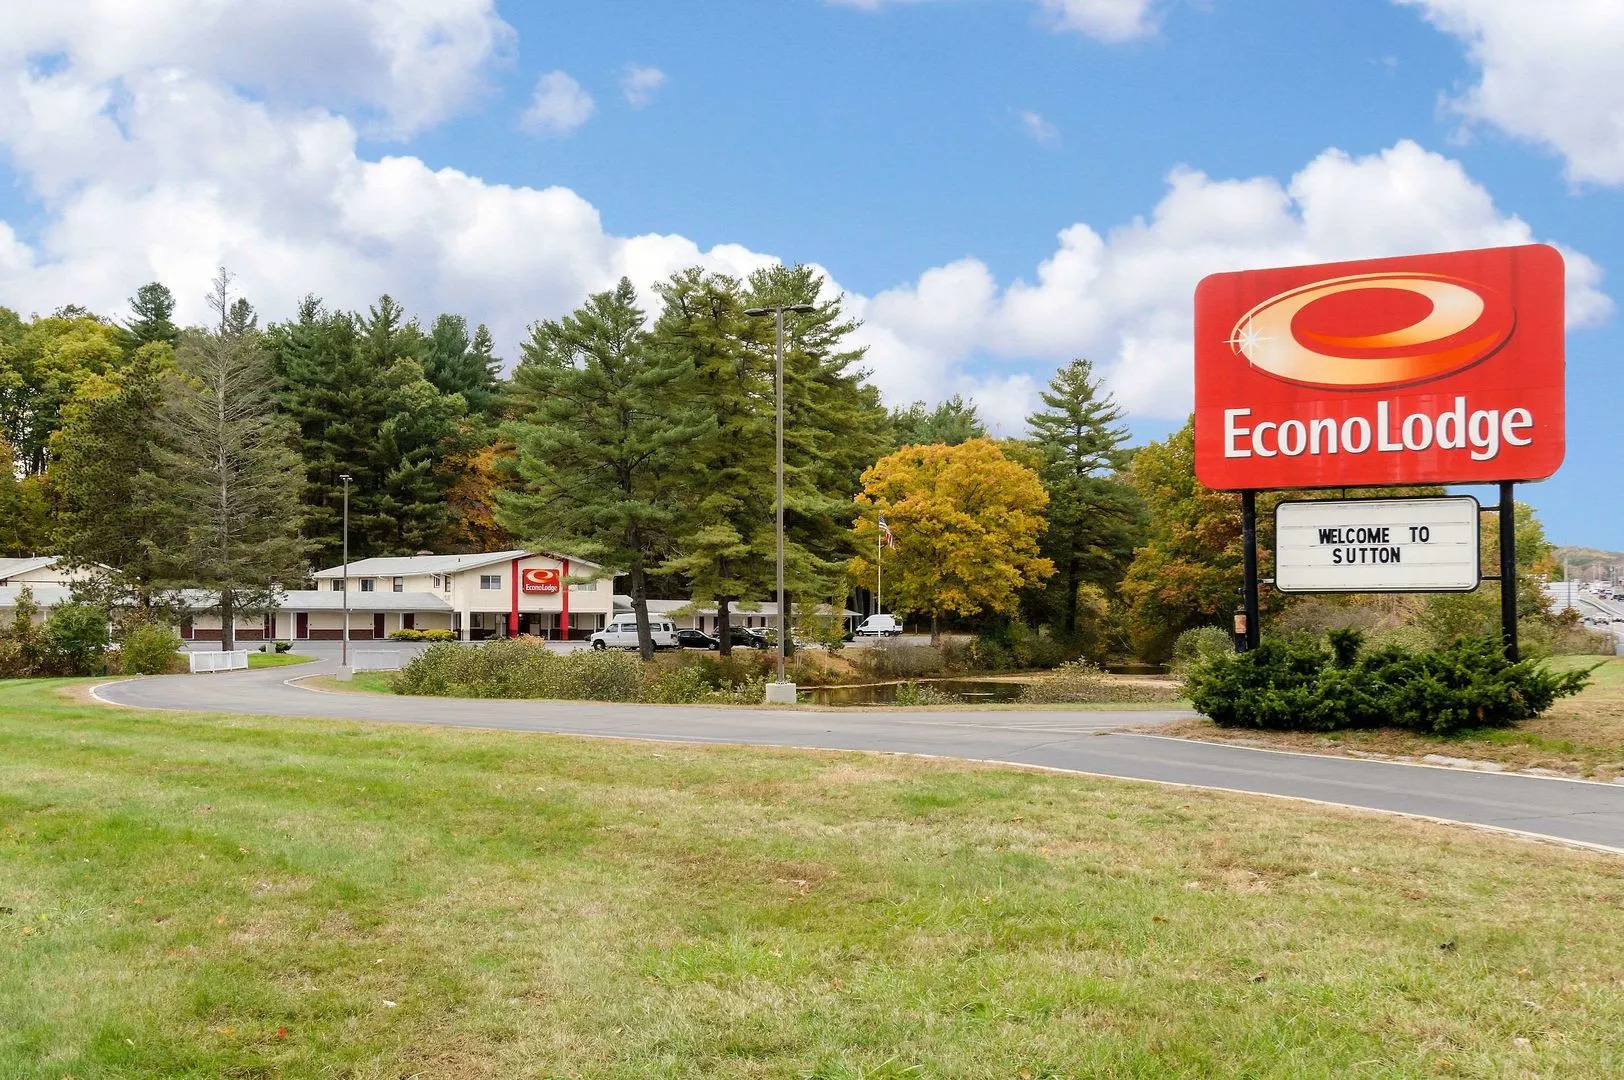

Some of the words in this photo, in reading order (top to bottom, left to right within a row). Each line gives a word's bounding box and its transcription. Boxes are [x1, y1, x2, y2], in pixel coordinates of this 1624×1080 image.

[1224, 397, 1533, 461] EconoLodge
[1319, 527, 1390, 544] WELCOME
[1409, 526, 1430, 543] TO
[1333, 547, 1401, 564] SUTTON
